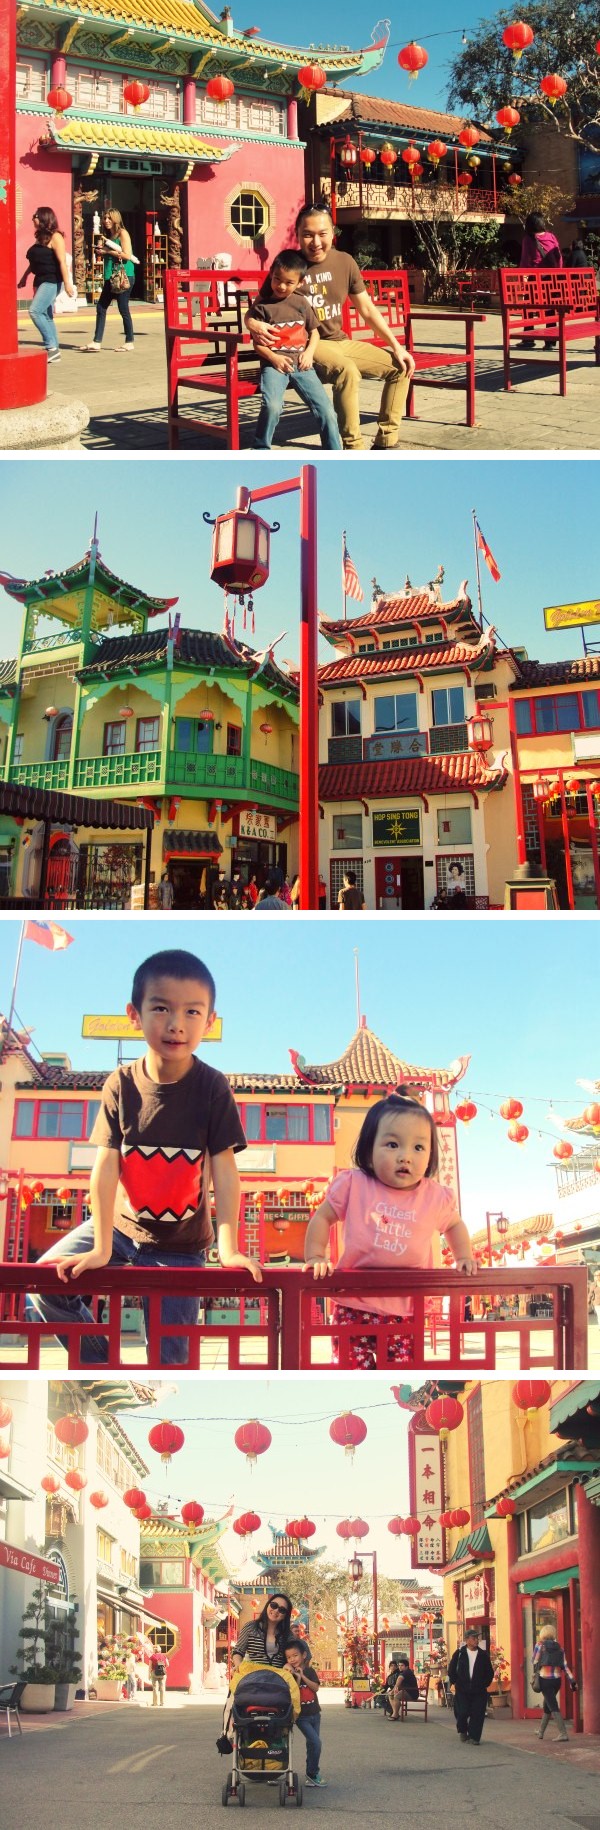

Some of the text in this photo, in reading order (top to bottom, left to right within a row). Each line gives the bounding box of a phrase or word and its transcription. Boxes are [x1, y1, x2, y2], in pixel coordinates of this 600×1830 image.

[315, 271, 332, 283] KIND
[310, 284, 328, 295] OF A
[374, 811, 418, 821] HOP SING TONG
[252, 828, 258, 837] A
[288, 1213, 310, 1221] GIFTS
[375, 1202, 417, 1223] Cutest
[376, 1220, 412, 1239] Little
[374, 1233, 408, 1257] Lady
[421, 1447, 437, 1531] 一本相命
[4, 1546, 19, 1566] Via
[21, 1556, 37, 1575] Cafe
